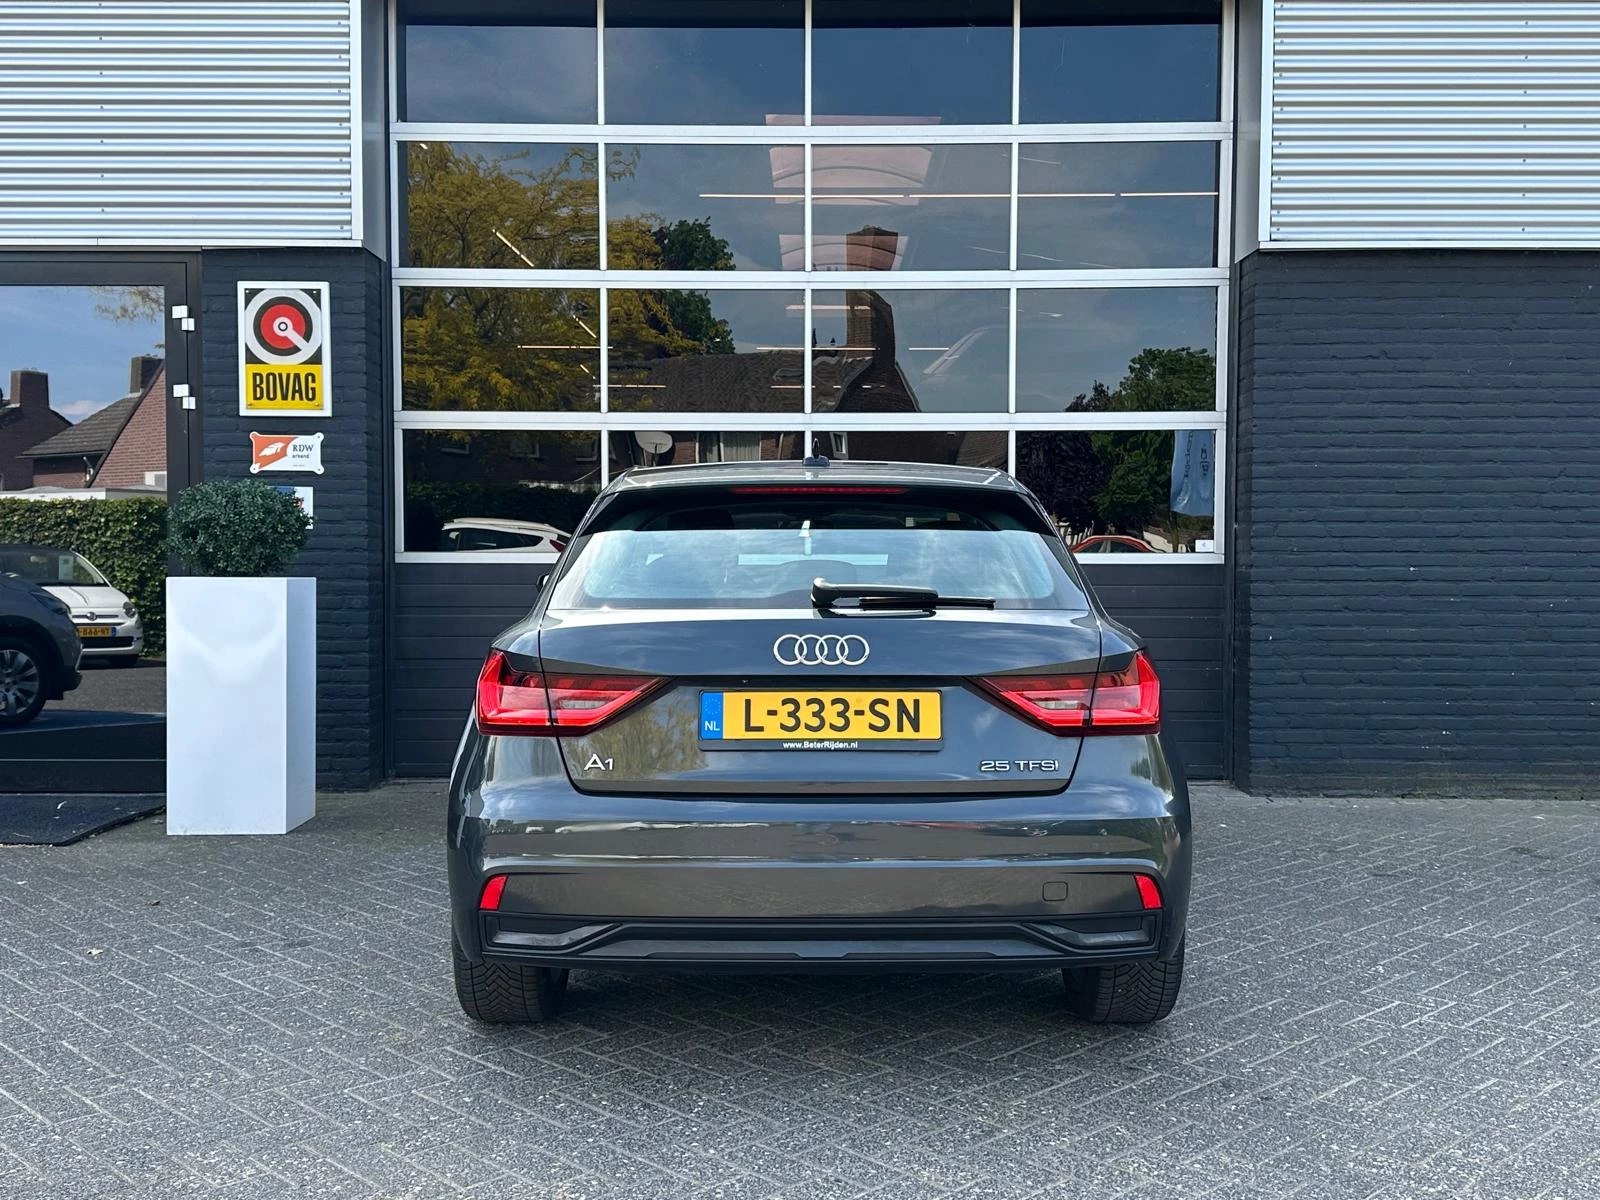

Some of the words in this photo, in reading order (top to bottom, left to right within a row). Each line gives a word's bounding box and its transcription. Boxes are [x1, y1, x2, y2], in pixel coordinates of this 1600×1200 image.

[252, 372, 316, 402] BOVAG
[292, 443, 314, 452] RDW
[744, 698, 921, 732] L-333-SN
[704, 721, 720, 731] NL
[783, 740, 858, 750] www.BeterRijden.nl
[584, 753, 614, 770] A1
[981, 760, 1010, 771] 25
[1015, 760, 1059, 771] TFSI
